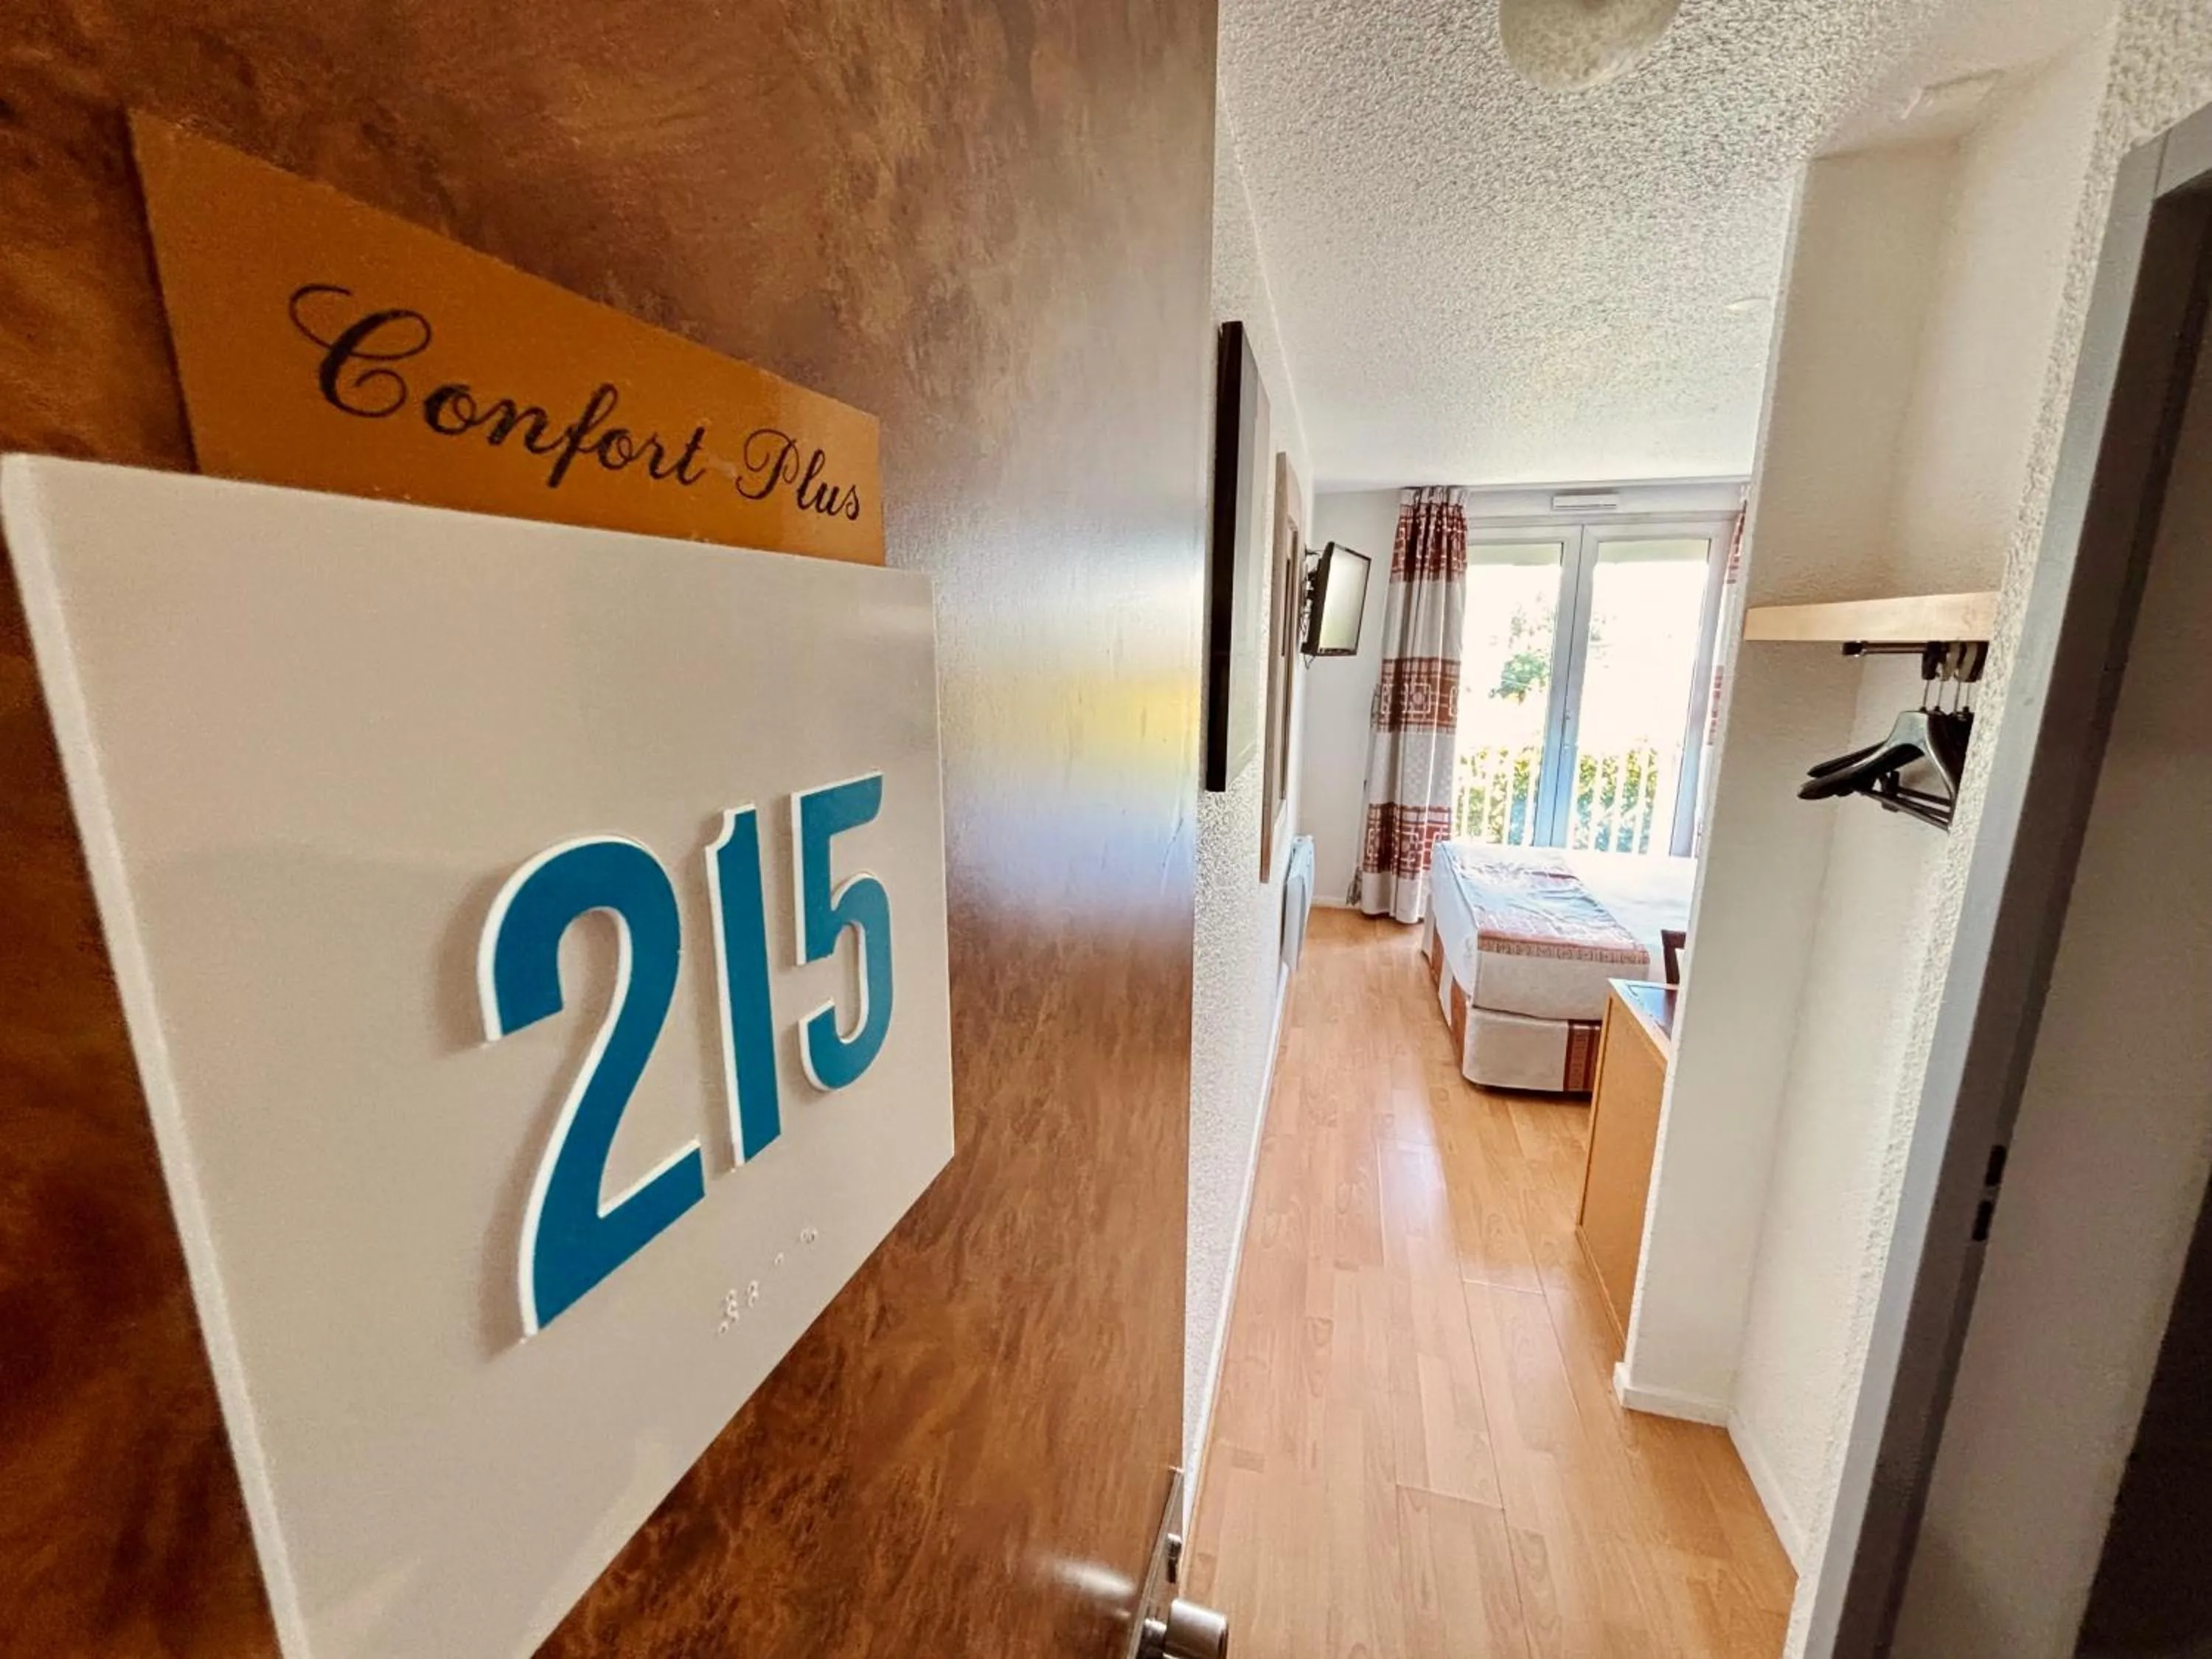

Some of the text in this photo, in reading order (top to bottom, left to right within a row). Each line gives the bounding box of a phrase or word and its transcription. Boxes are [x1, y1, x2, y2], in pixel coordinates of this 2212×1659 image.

[288, 283, 861, 521] Confort Plus
[476, 770, 894, 1342] 215
